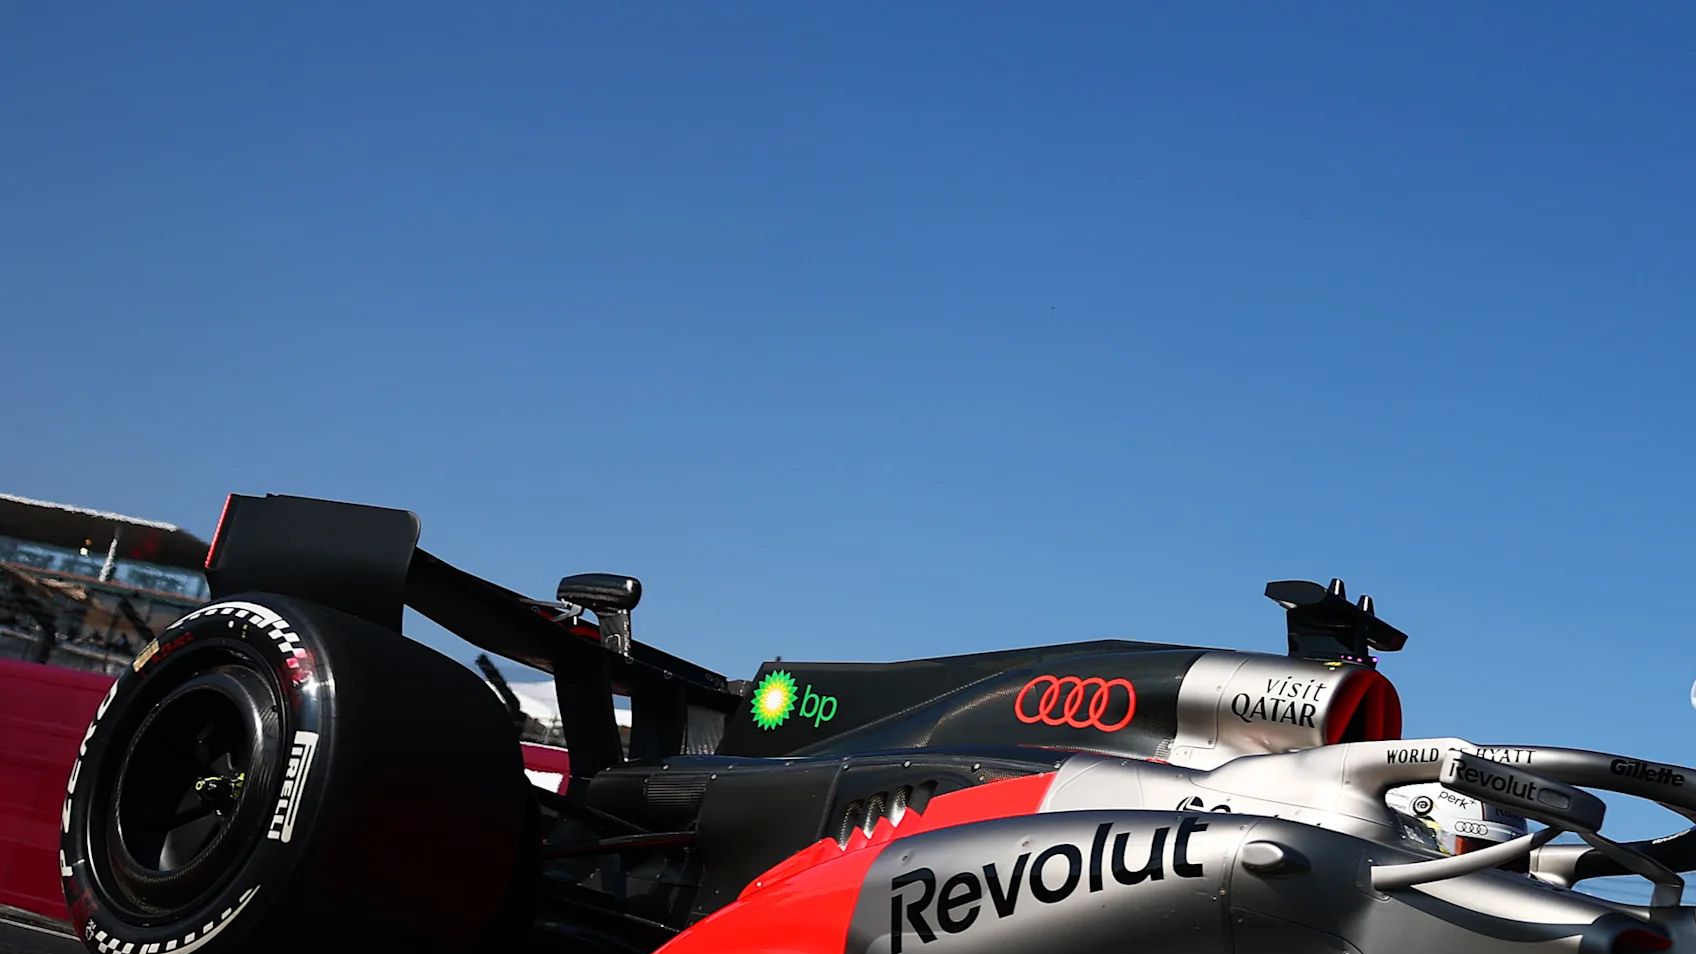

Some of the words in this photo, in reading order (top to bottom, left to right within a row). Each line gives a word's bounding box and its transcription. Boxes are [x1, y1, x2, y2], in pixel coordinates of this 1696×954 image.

[799, 684, 838, 728] bp
[1266, 676, 1327, 702] visit
[1231, 692, 1316, 729] QATAR
[1387, 747, 1439, 764] WORLD
[1610, 758, 1685, 787] Gillette
[267, 730, 320, 843] PIRELLI
[1449, 757, 1537, 801] Revolut
